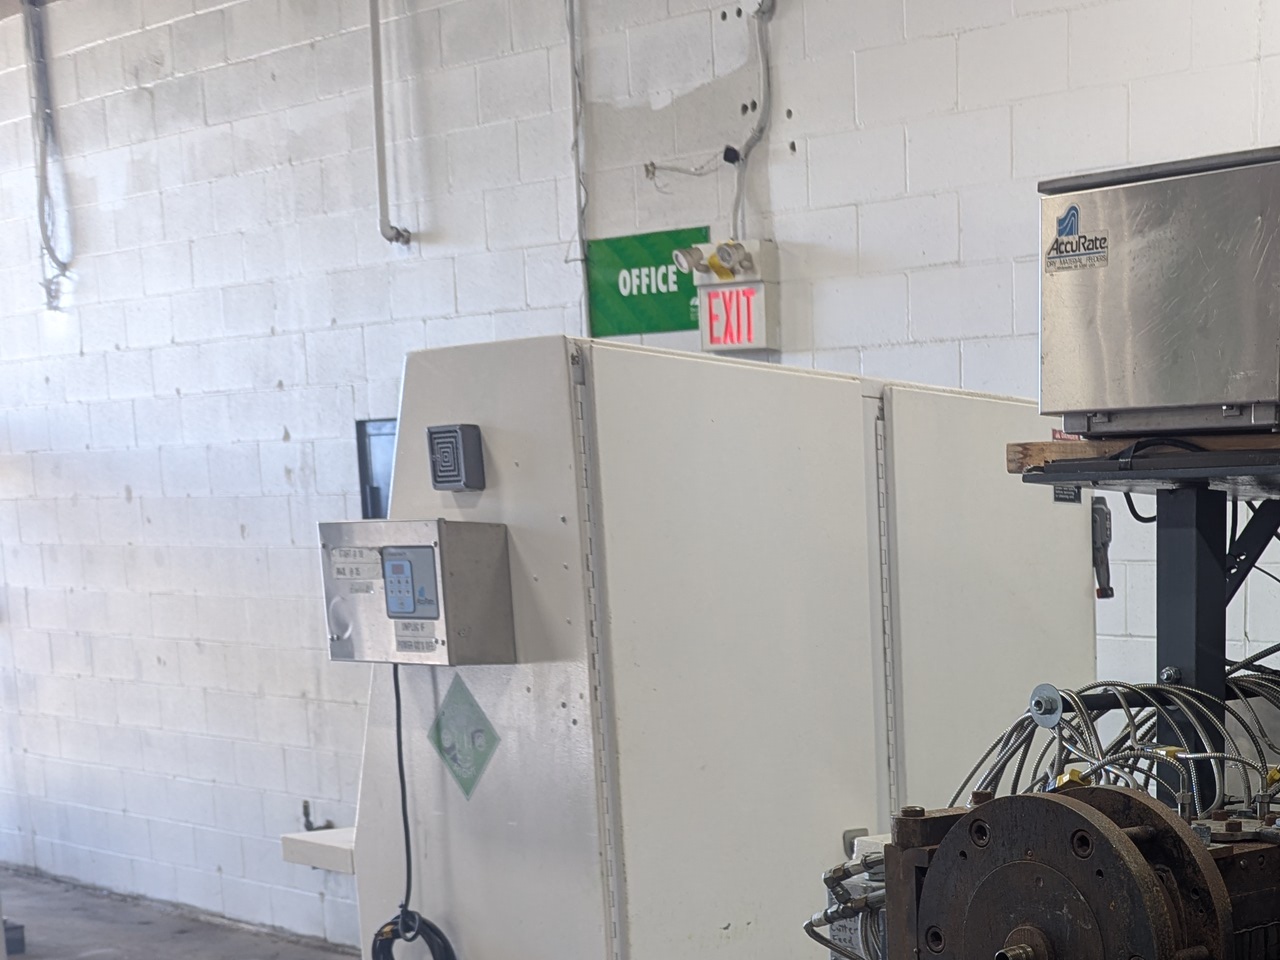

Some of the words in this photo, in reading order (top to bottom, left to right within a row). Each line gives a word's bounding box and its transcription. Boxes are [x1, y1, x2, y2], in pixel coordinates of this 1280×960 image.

[1047, 235, 1108, 256] AccuRate
[618, 264, 679, 297] OFFICE
[708, 287, 757, 345] EXIT
[831, 922, 859, 935] Cutter
[832, 934, 855, 947] Feed
